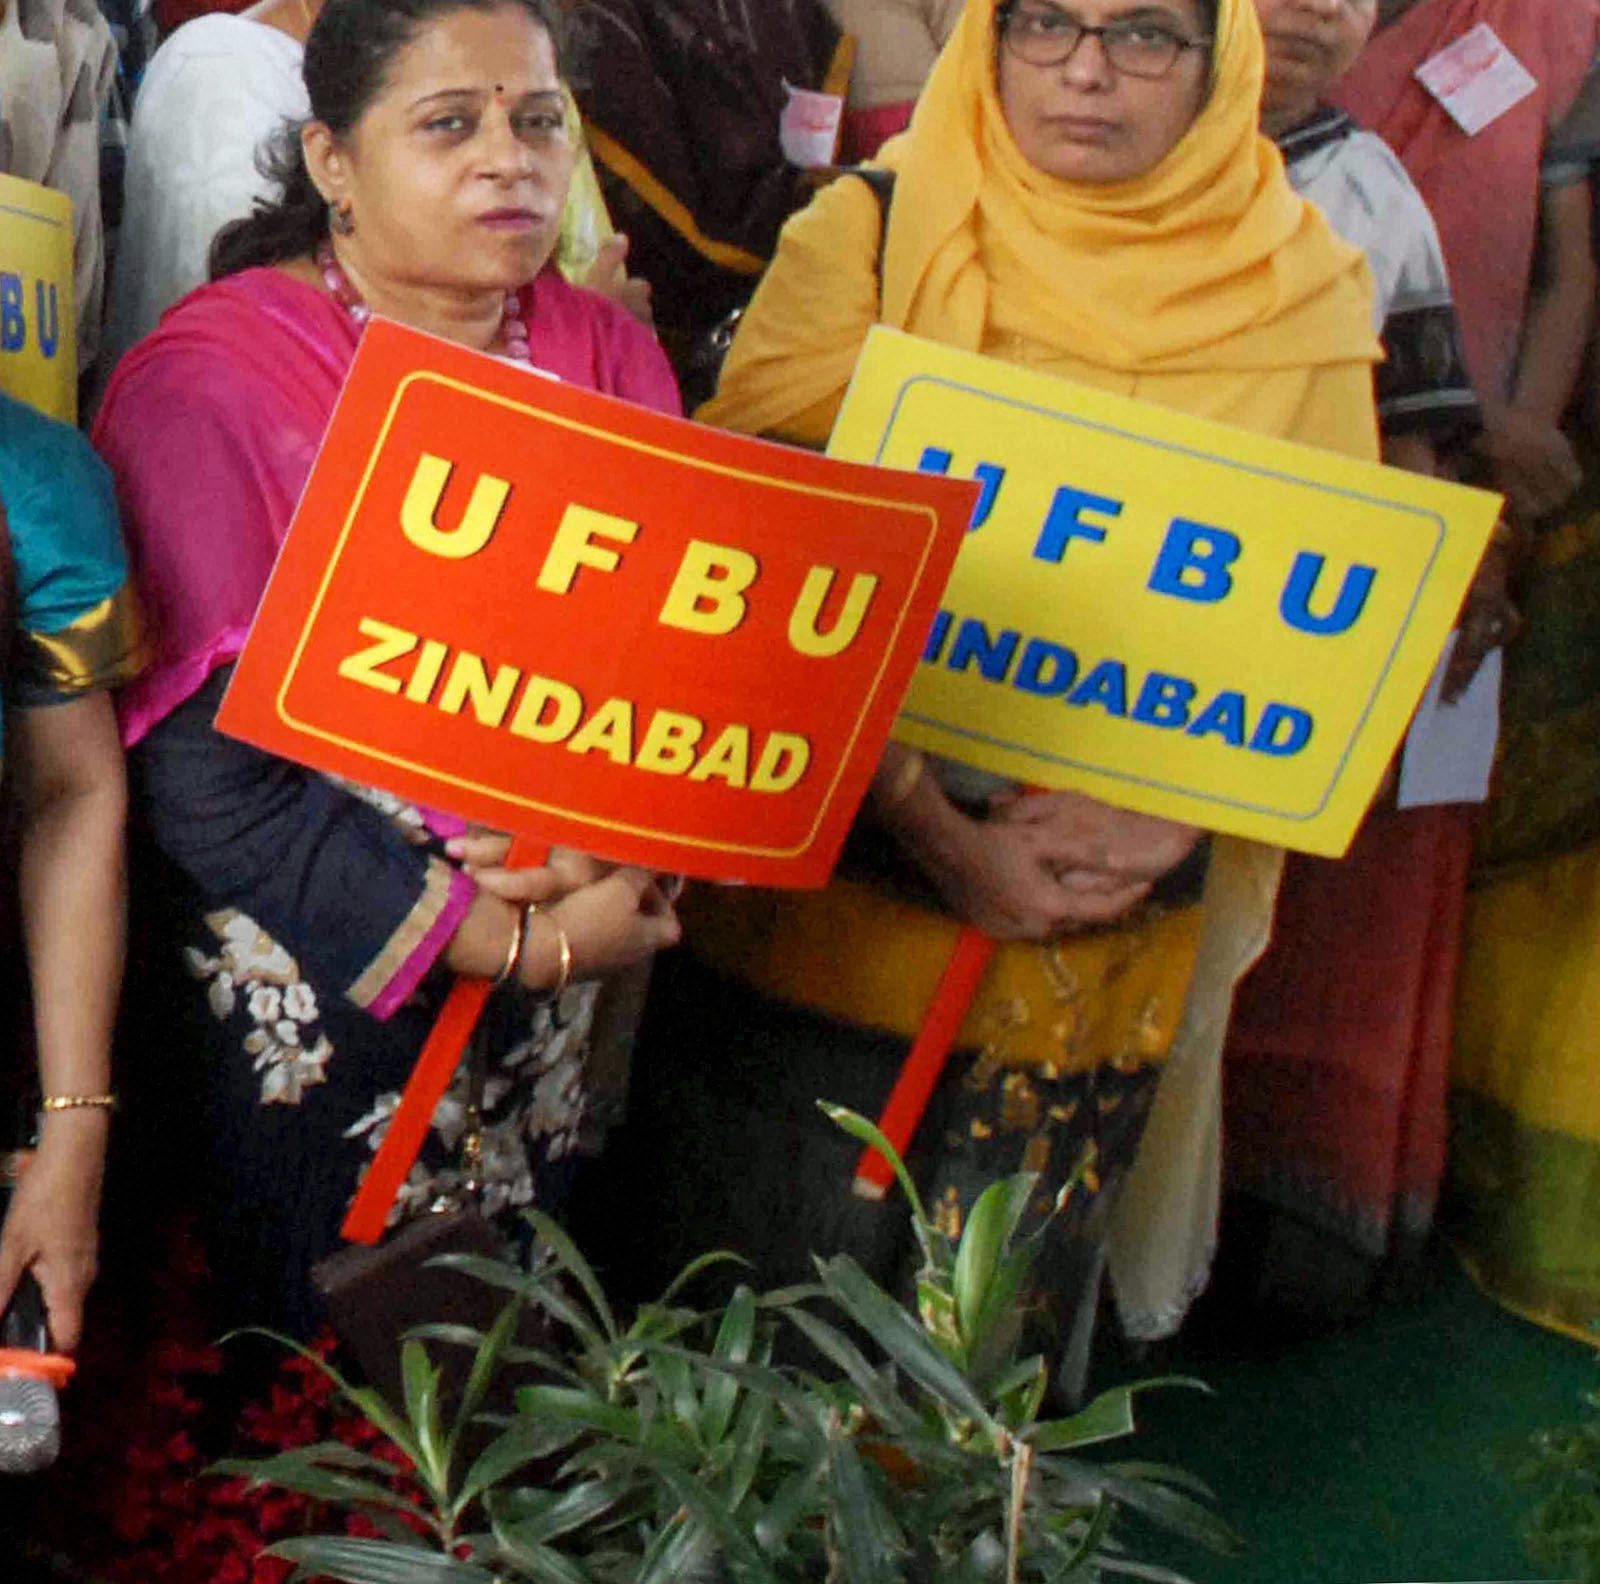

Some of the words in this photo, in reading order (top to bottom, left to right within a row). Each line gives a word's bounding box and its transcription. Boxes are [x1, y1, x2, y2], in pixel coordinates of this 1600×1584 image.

[399, 452, 879, 658] UFBU
[337, 616, 812, 794] ZINDABAD
[920, 609, 1314, 758] INDABAD
